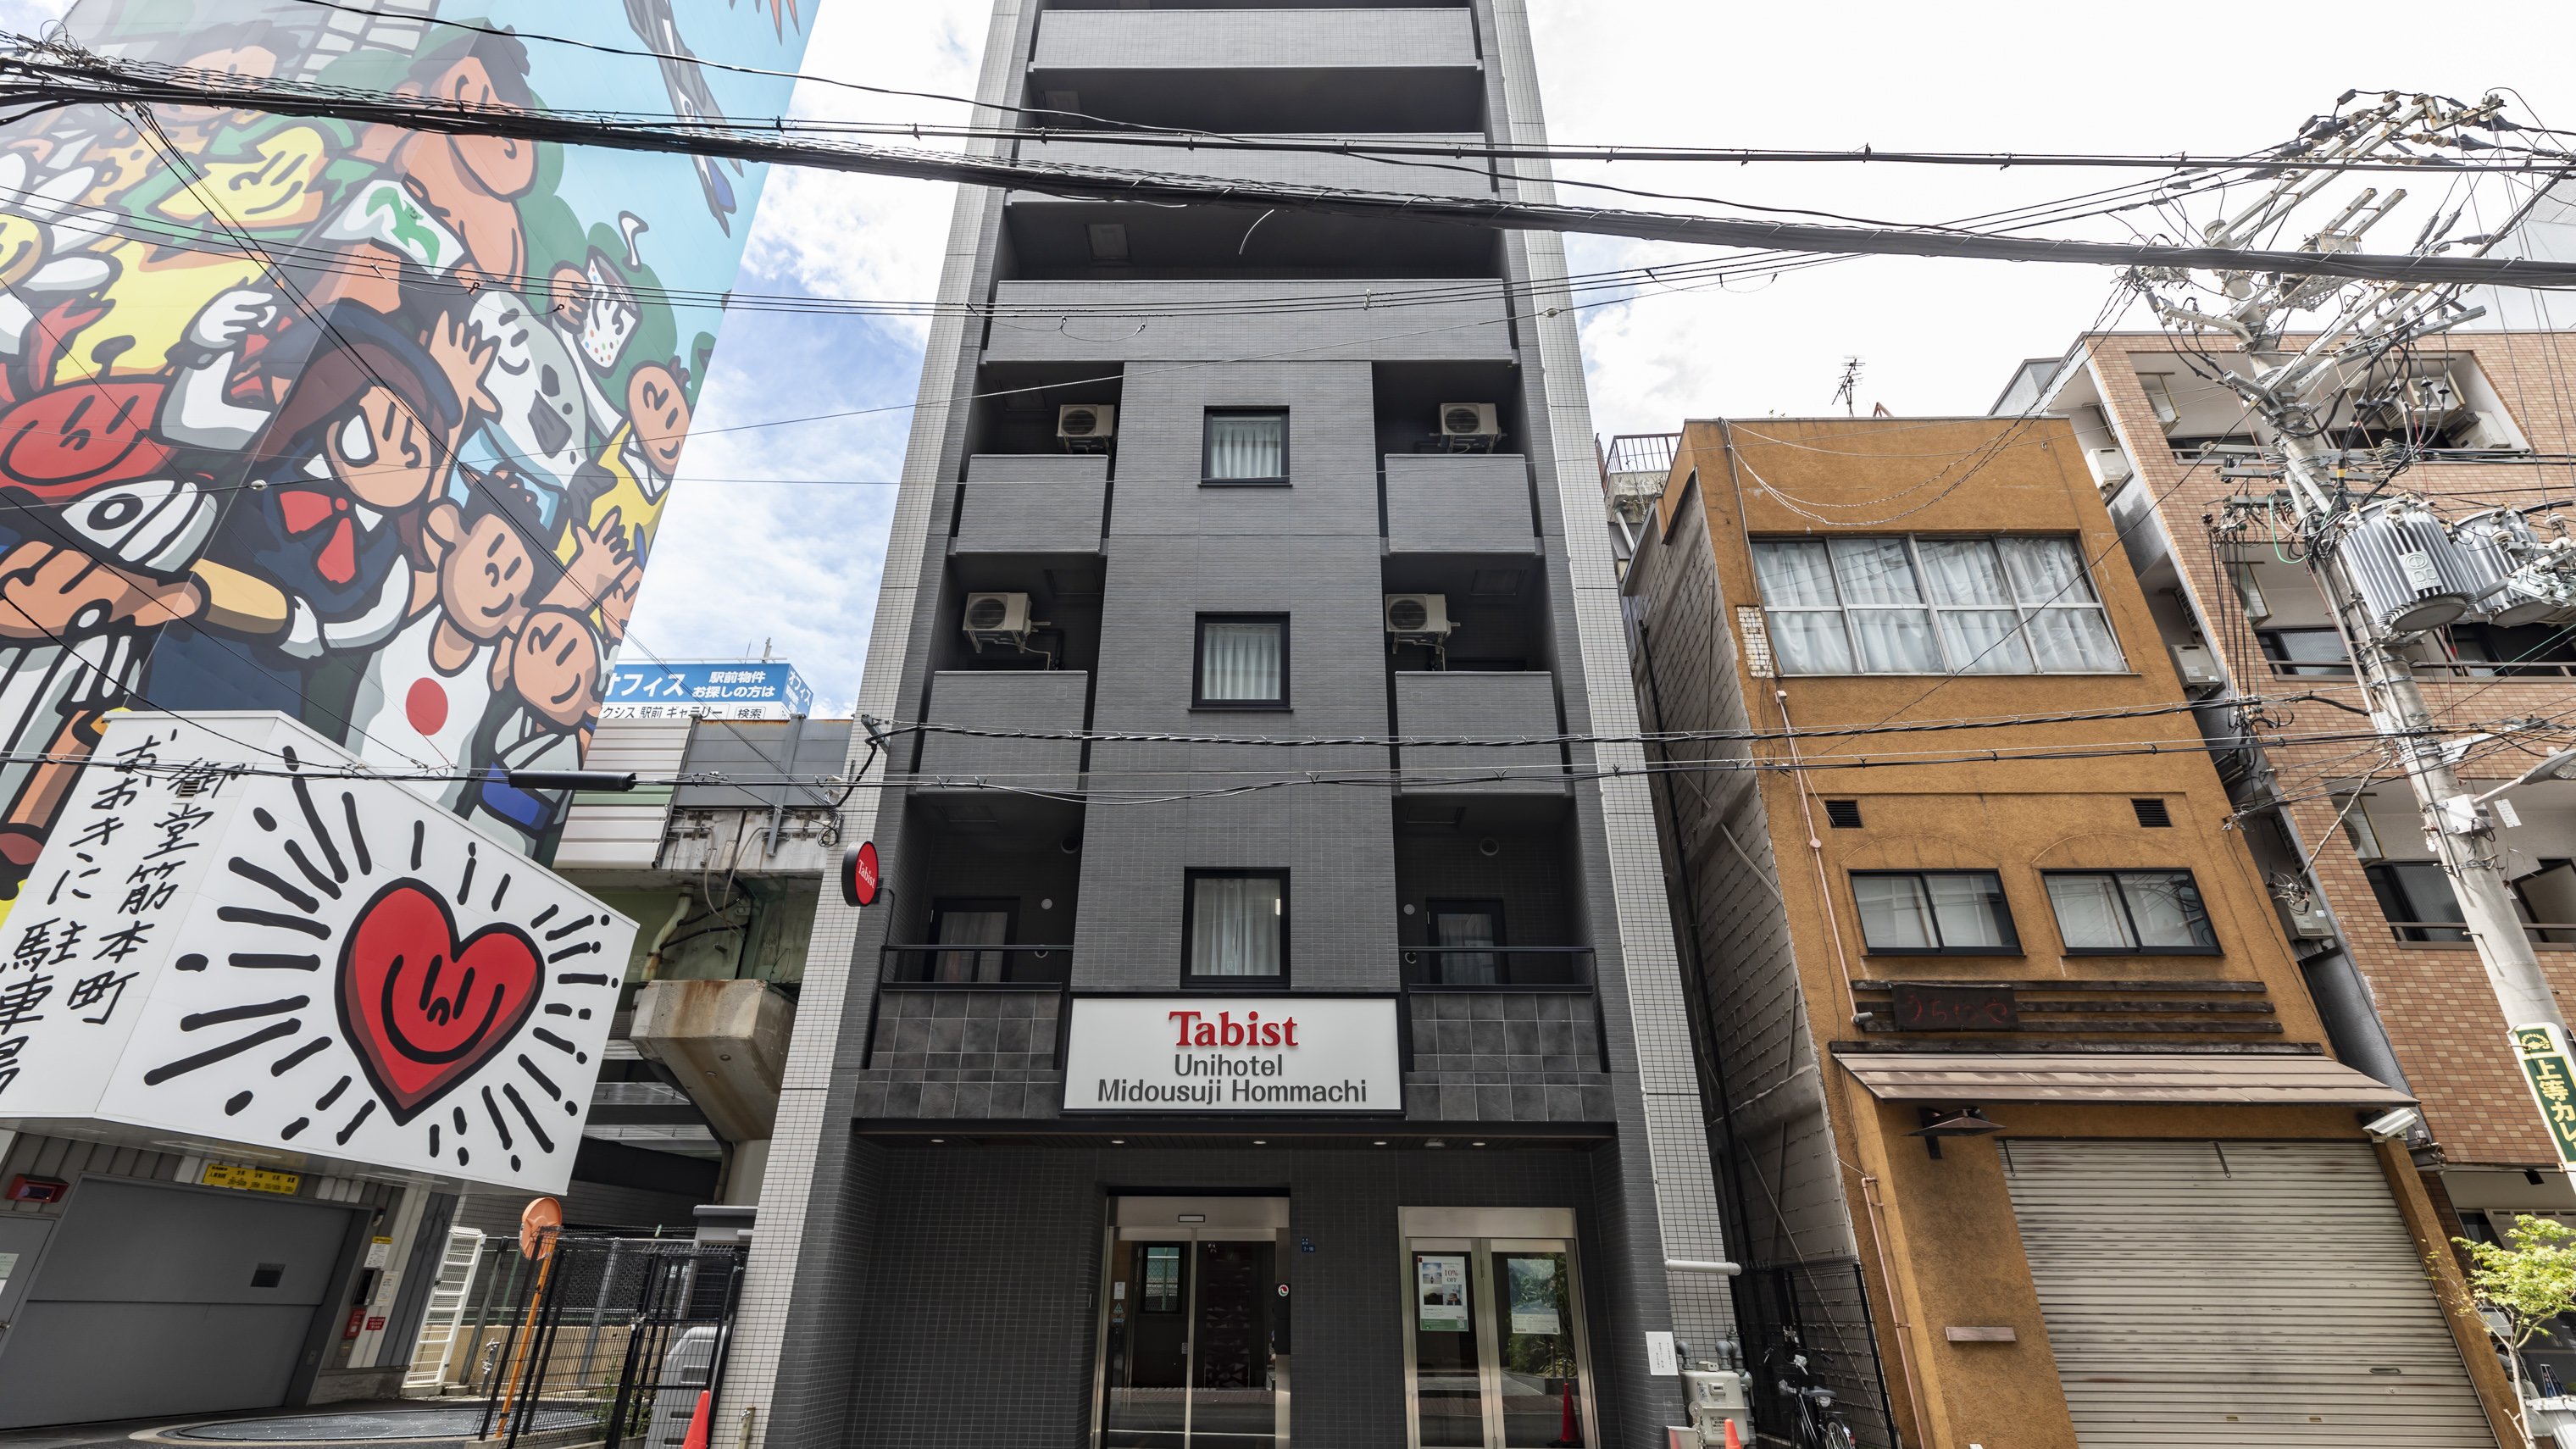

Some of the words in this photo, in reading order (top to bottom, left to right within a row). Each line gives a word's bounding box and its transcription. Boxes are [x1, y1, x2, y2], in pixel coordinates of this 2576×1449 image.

[709, 671, 766, 684] 駅前物件
[692, 686, 775, 698] お探しの方は
[601, 706, 636, 719] クシス
[639, 706, 663, 719] 駅前
[737, 708, 763, 719] 検索
[858, 859, 875, 889] Tabist
[67, 757, 247, 1025] 御堂筋本町
[1169, 1011, 1299, 1047] Tabist
[1174, 1053, 1283, 1077] Unihotel
[1098, 1079, 1221, 1105] Midousuji
[1233, 1080, 1367, 1103] Hommachi
[2536, 1059, 2576, 1151] 上等カレ
